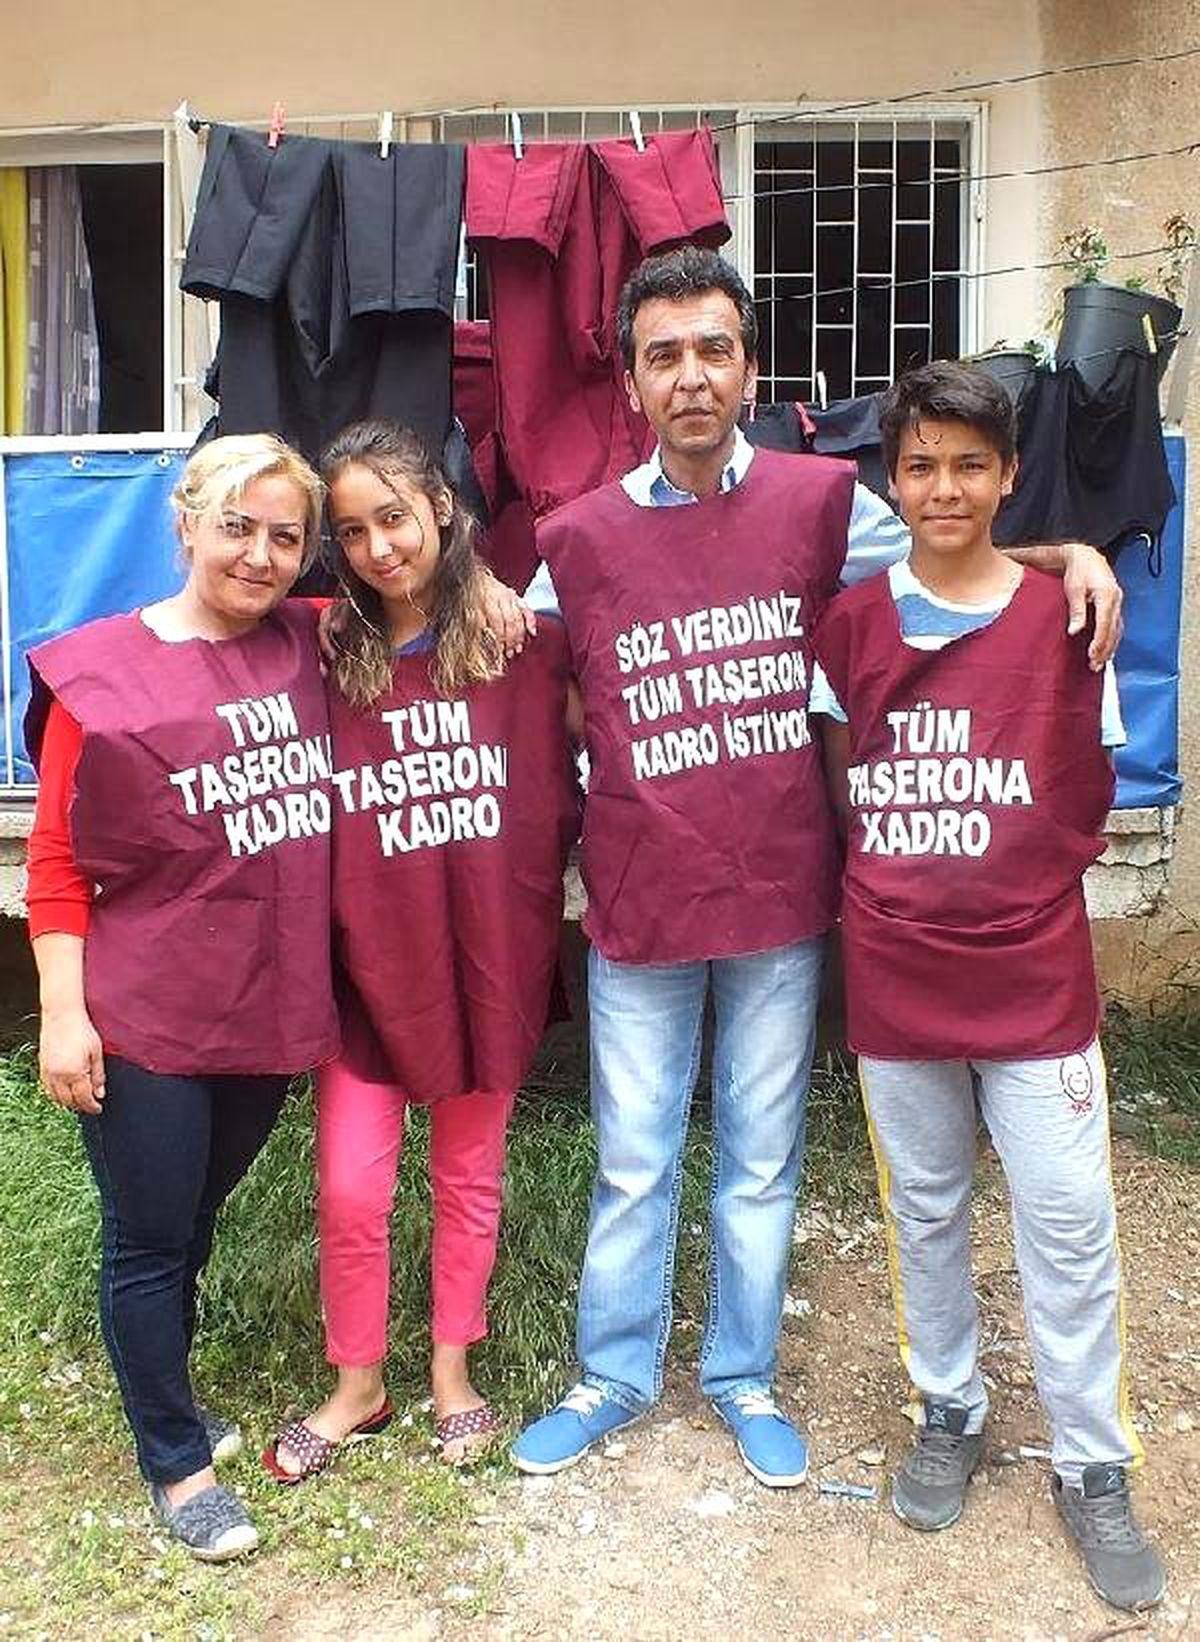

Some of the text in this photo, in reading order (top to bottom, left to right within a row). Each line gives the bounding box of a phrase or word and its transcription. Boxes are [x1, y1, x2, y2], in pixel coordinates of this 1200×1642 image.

[615, 589, 803, 673] SÖZ VERDİNİZ
[215, 692, 299, 747] TÜM
[381, 700, 471, 752] TÜM
[621, 672, 683, 725] TÜM
[631, 723, 719, 780] KADRO
[887, 701, 971, 753] TÜM
[222, 789, 331, 857] KADRO
[377, 793, 501, 857] KADRO
